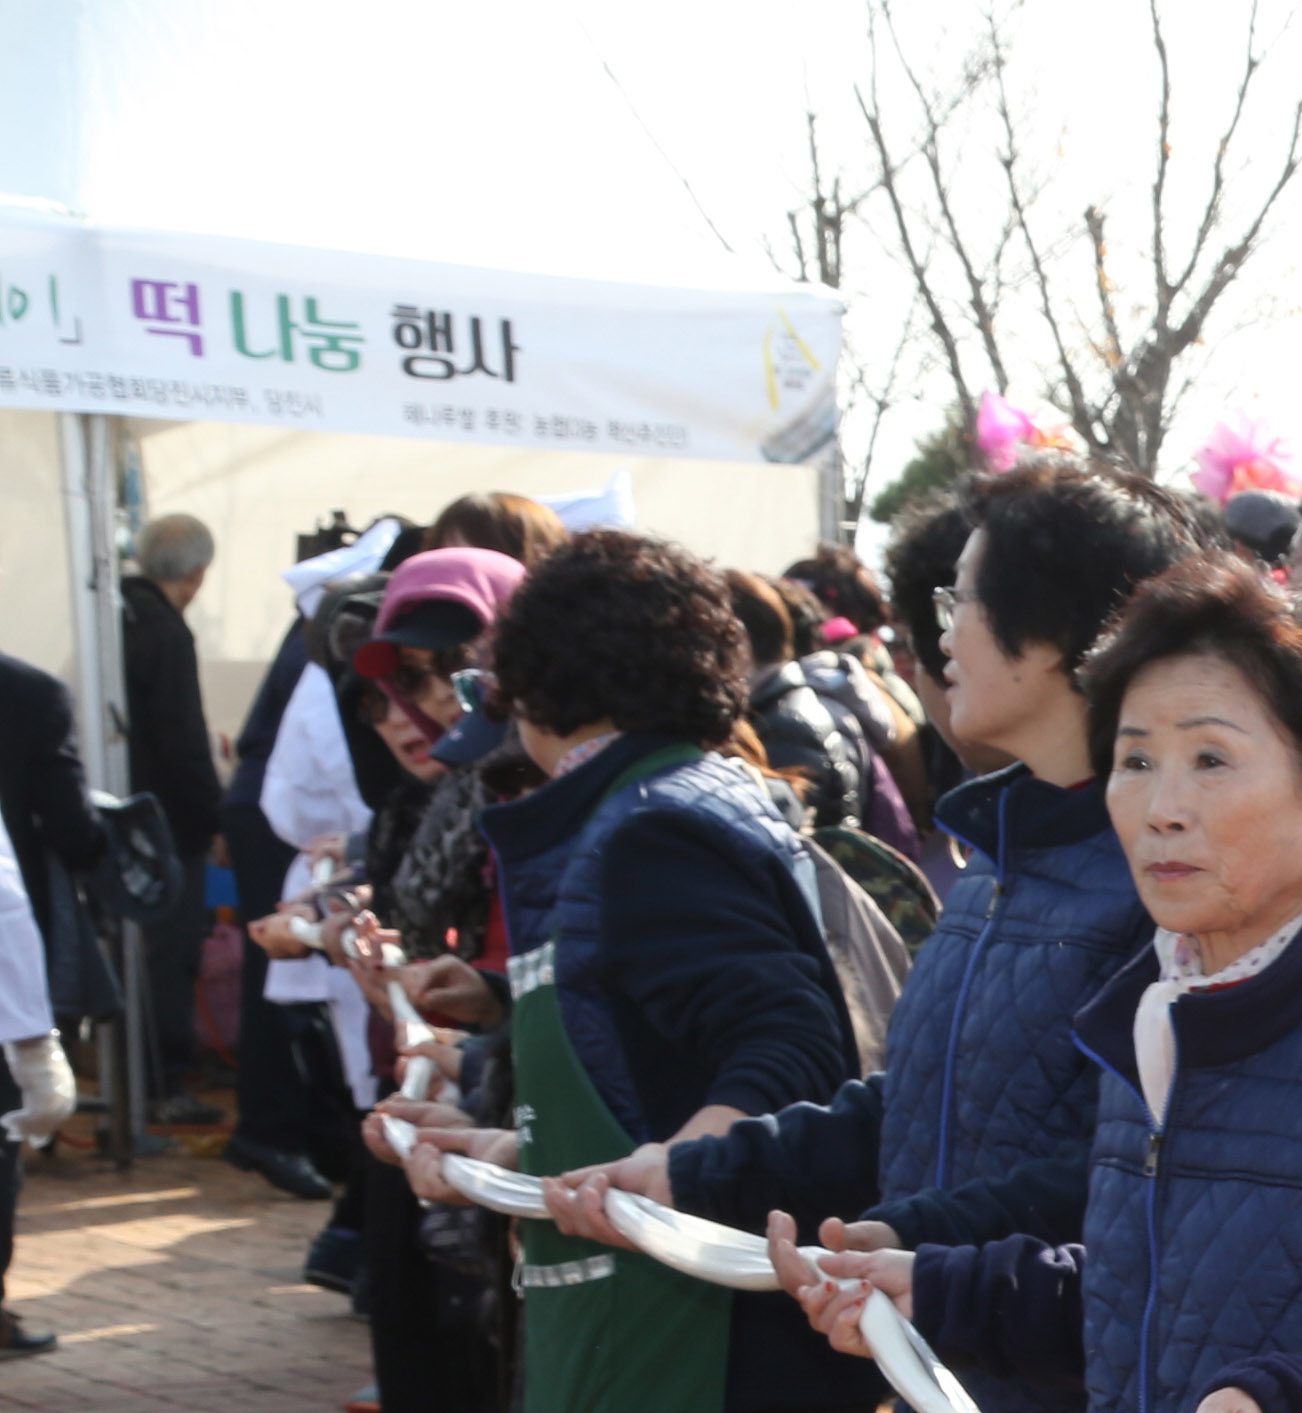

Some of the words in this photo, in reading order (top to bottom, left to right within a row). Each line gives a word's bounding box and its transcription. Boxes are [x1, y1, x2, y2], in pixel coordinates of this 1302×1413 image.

[130, 277, 205, 358] 떡
[229, 289, 366, 373] 나눔
[391, 302, 522, 384] 행사
